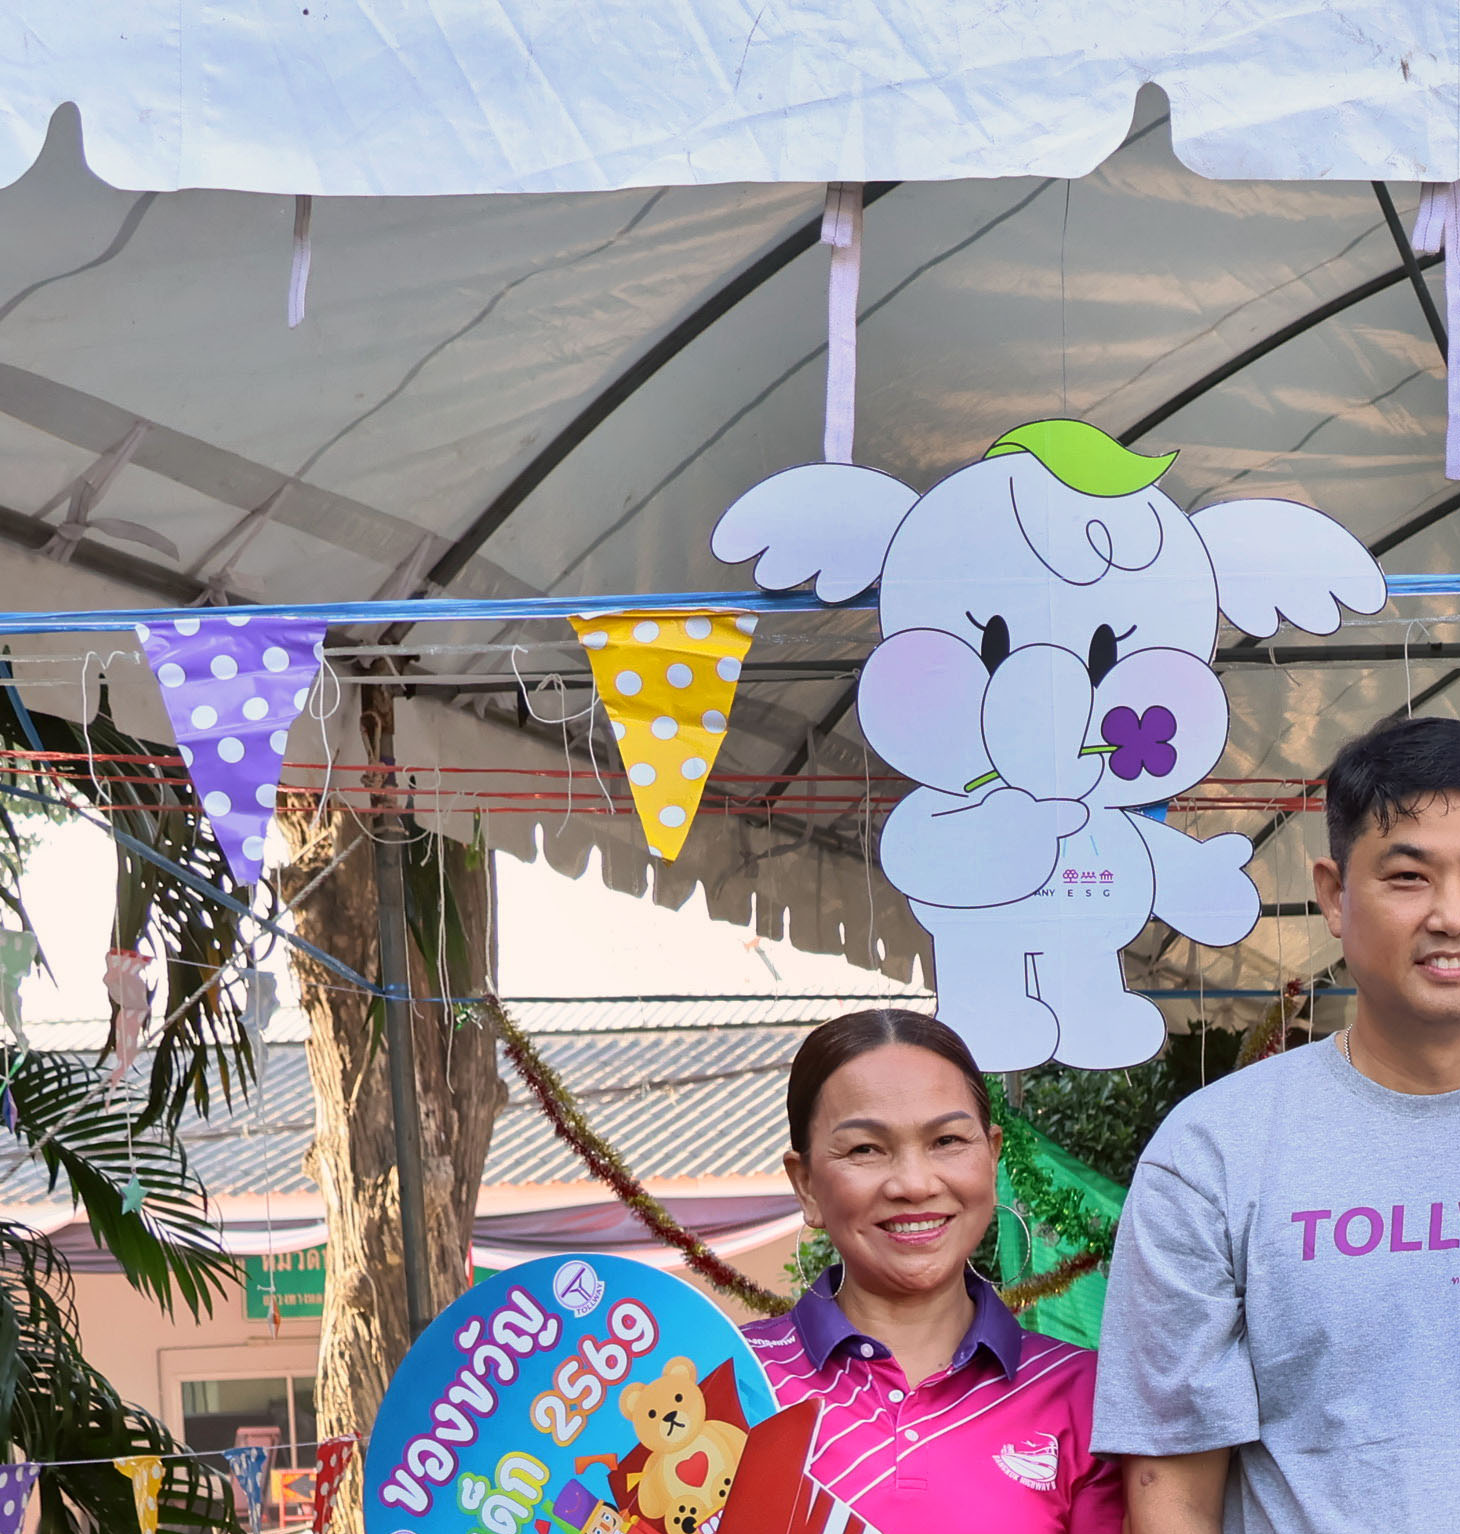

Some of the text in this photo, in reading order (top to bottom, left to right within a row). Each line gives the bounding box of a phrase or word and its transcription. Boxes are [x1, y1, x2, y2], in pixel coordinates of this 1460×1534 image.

[1067, 889, 1074, 897] E
[1085, 889, 1092, 897] S
[1103, 889, 1110, 897] G
[576, 1282, 603, 1315] TOLLWAY
[381, 1287, 561, 1514] ของขวัญ
[531, 1299, 658, 1445] 2569
